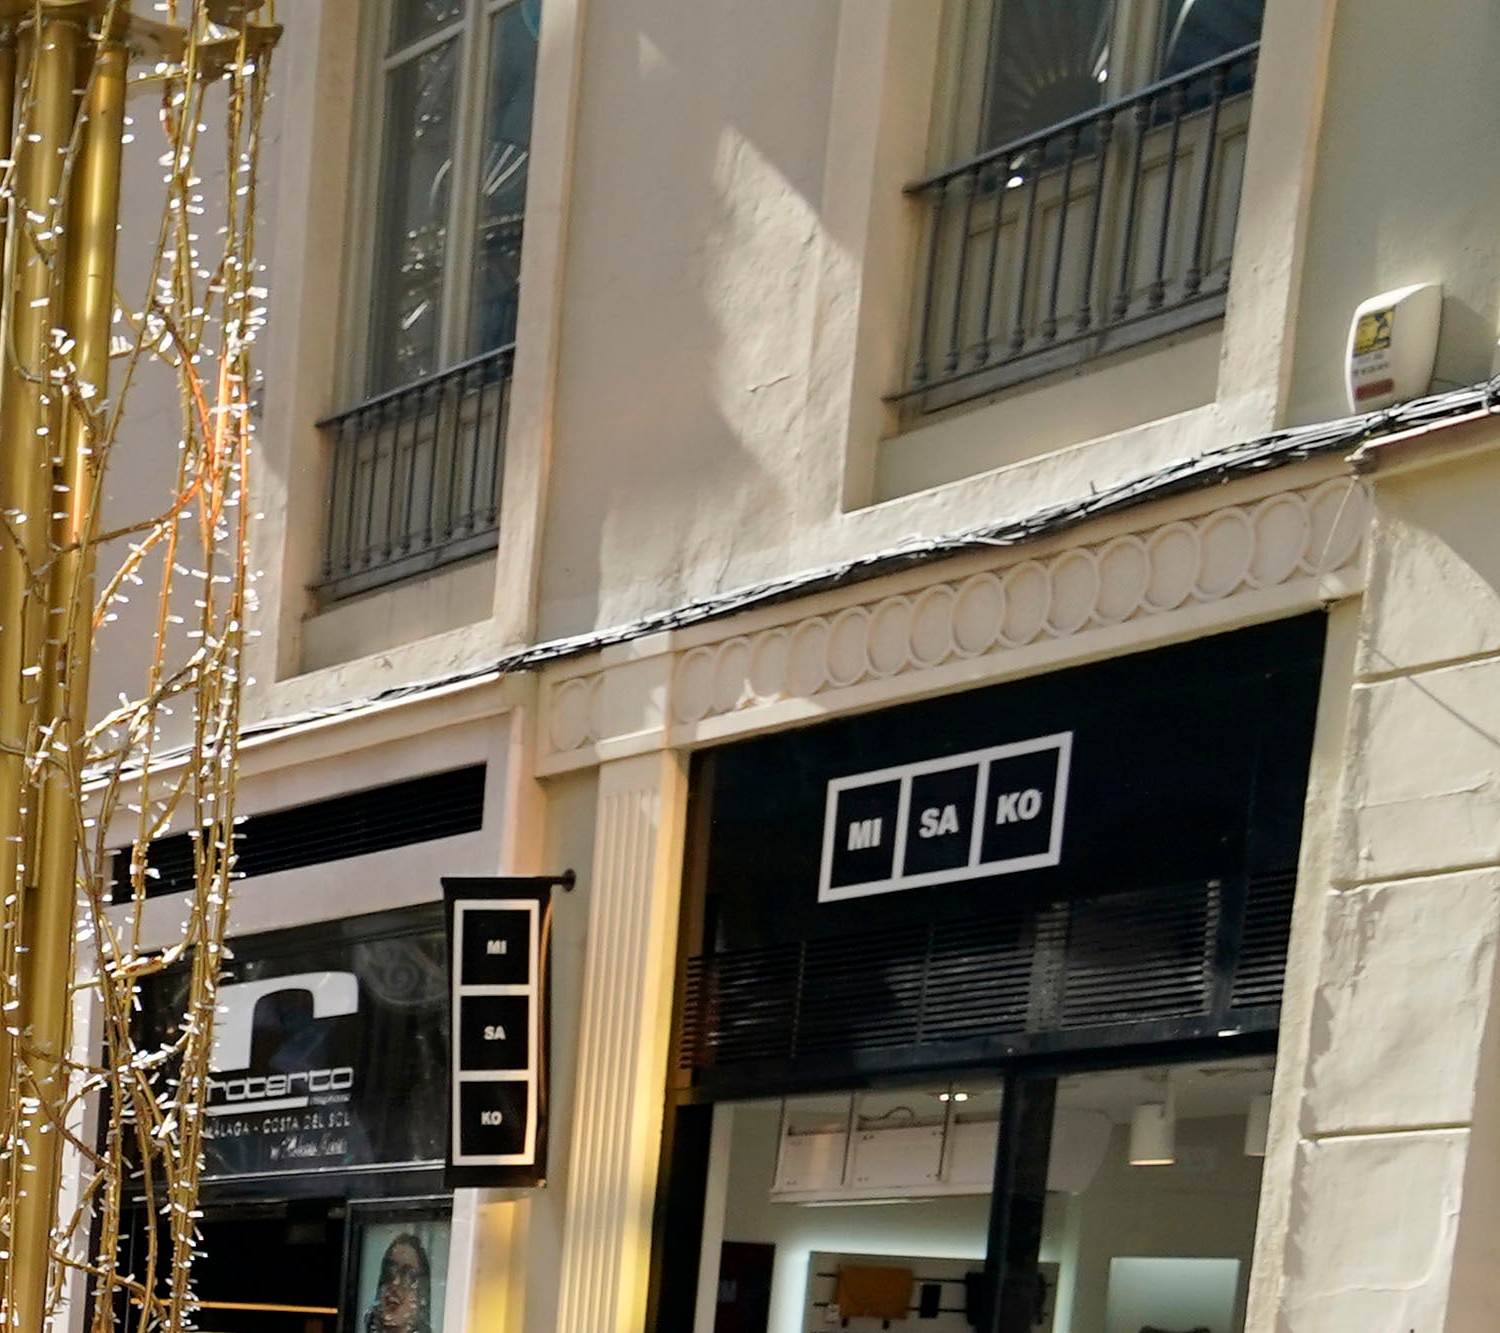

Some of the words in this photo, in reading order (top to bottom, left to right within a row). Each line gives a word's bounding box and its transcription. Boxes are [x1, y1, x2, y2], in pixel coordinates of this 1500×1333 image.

[847, 816, 883, 851] MI
[918, 804, 960, 839] SA
[995, 788, 1043, 825] KO
[486, 939, 508, 955] MI
[483, 1025, 506, 1041] SA
[480, 1110, 503, 1126] KO
